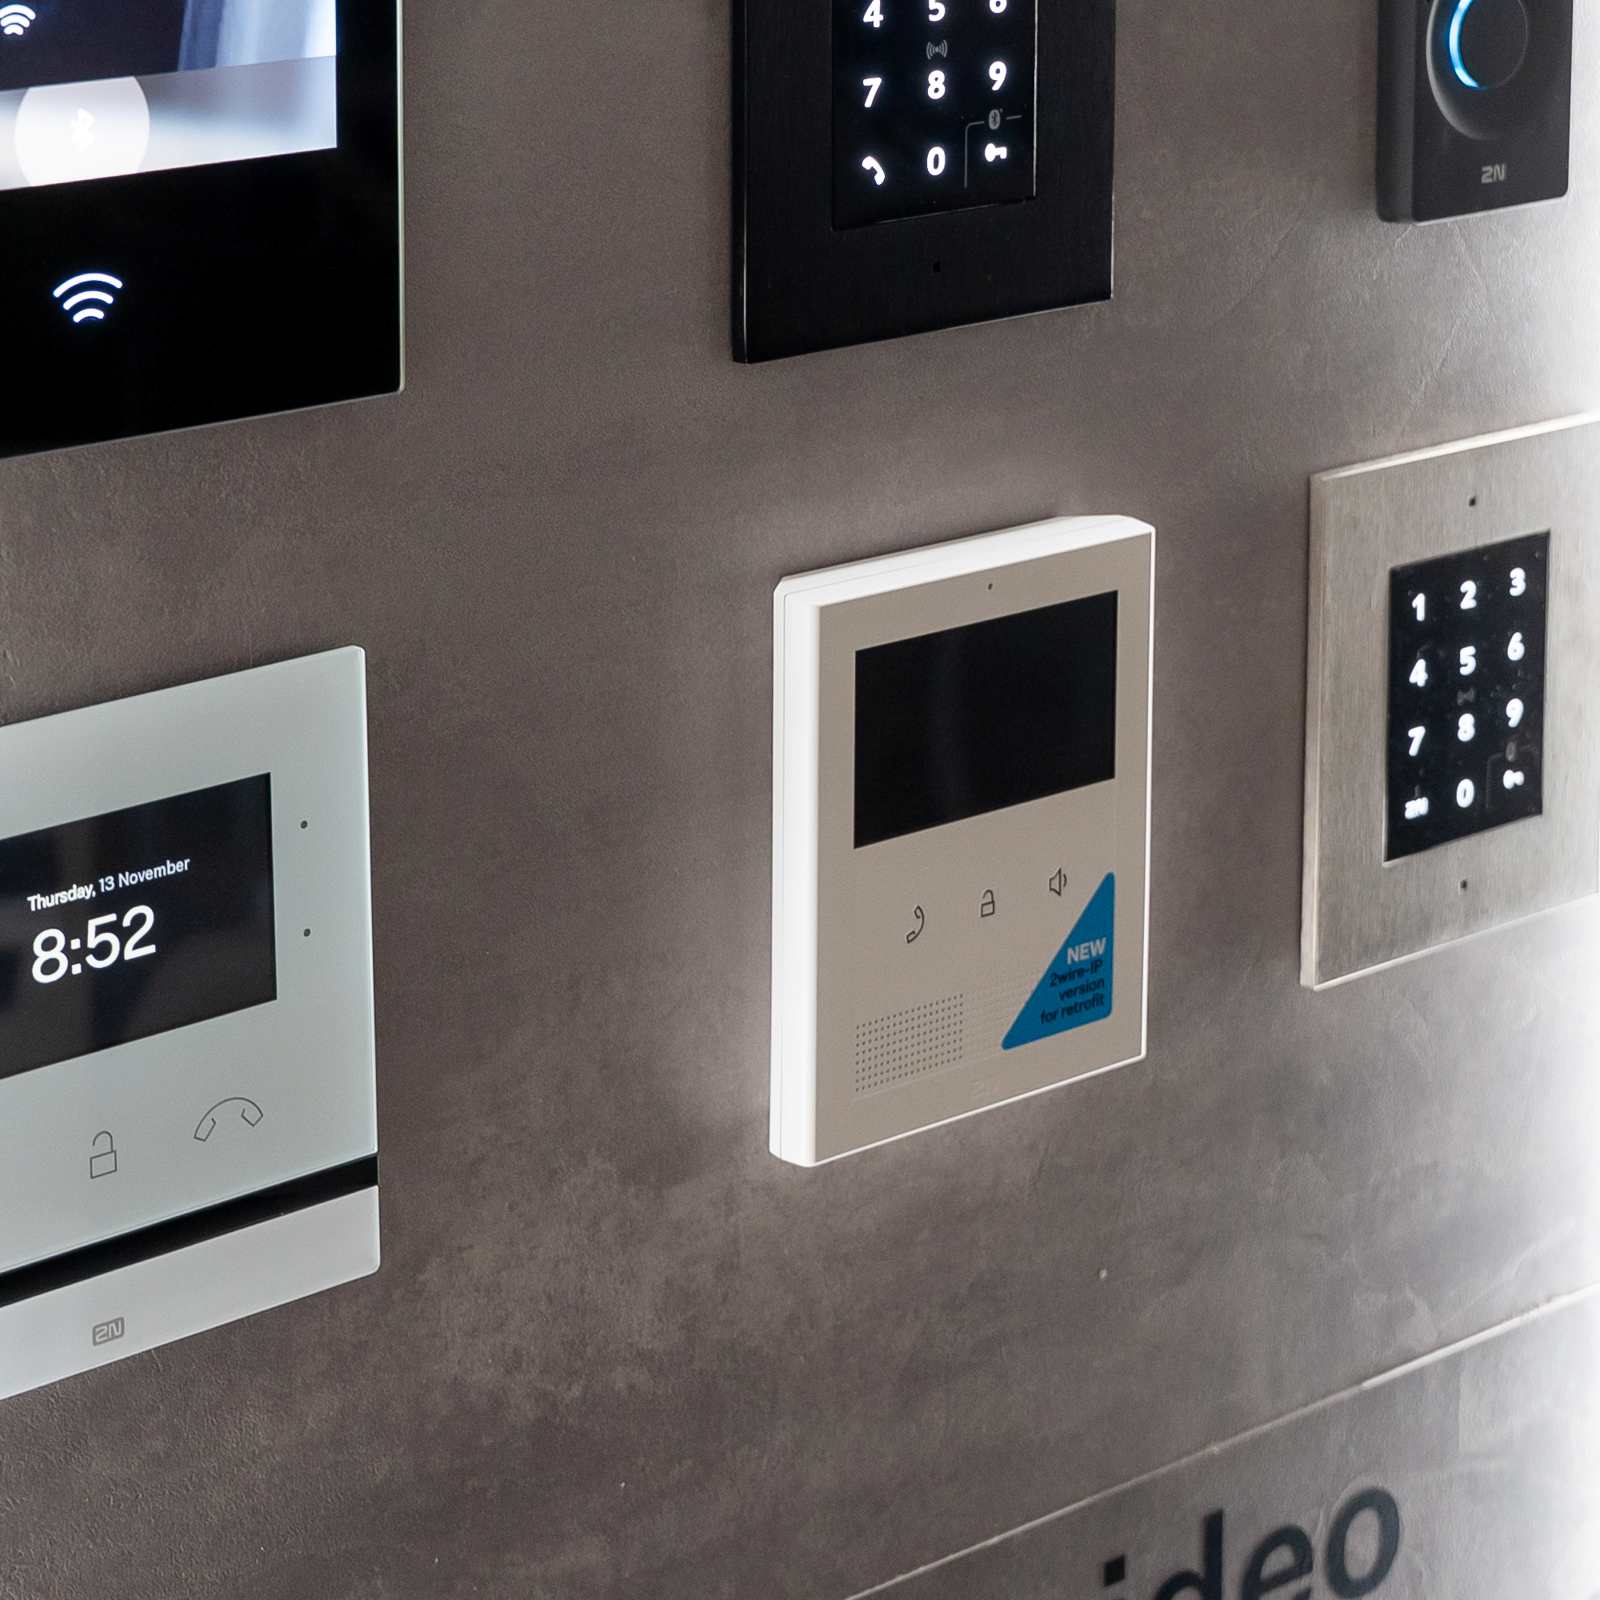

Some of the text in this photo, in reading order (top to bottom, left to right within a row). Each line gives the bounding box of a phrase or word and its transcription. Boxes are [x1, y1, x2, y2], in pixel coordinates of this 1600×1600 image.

[862, 60, 1008, 108] 7 8 9
[926, 145, 946, 176] 0
[1481, 163, 1507, 184] 2N
[1411, 567, 1527, 622] 1 2 3
[1408, 631, 1526, 688] 4 5 6
[1407, 697, 1525, 757] 7 8 9
[1455, 778, 1476, 809] 0
[26, 858, 191, 912] Thursday, 13 November
[31, 904, 157, 984] 8:52
[1066, 937, 1107, 965] NEW
[1059, 978, 1105, 1001] version
[1040, 992, 1105, 1025] for retrofit
[95, 1319, 123, 1343] 2N
